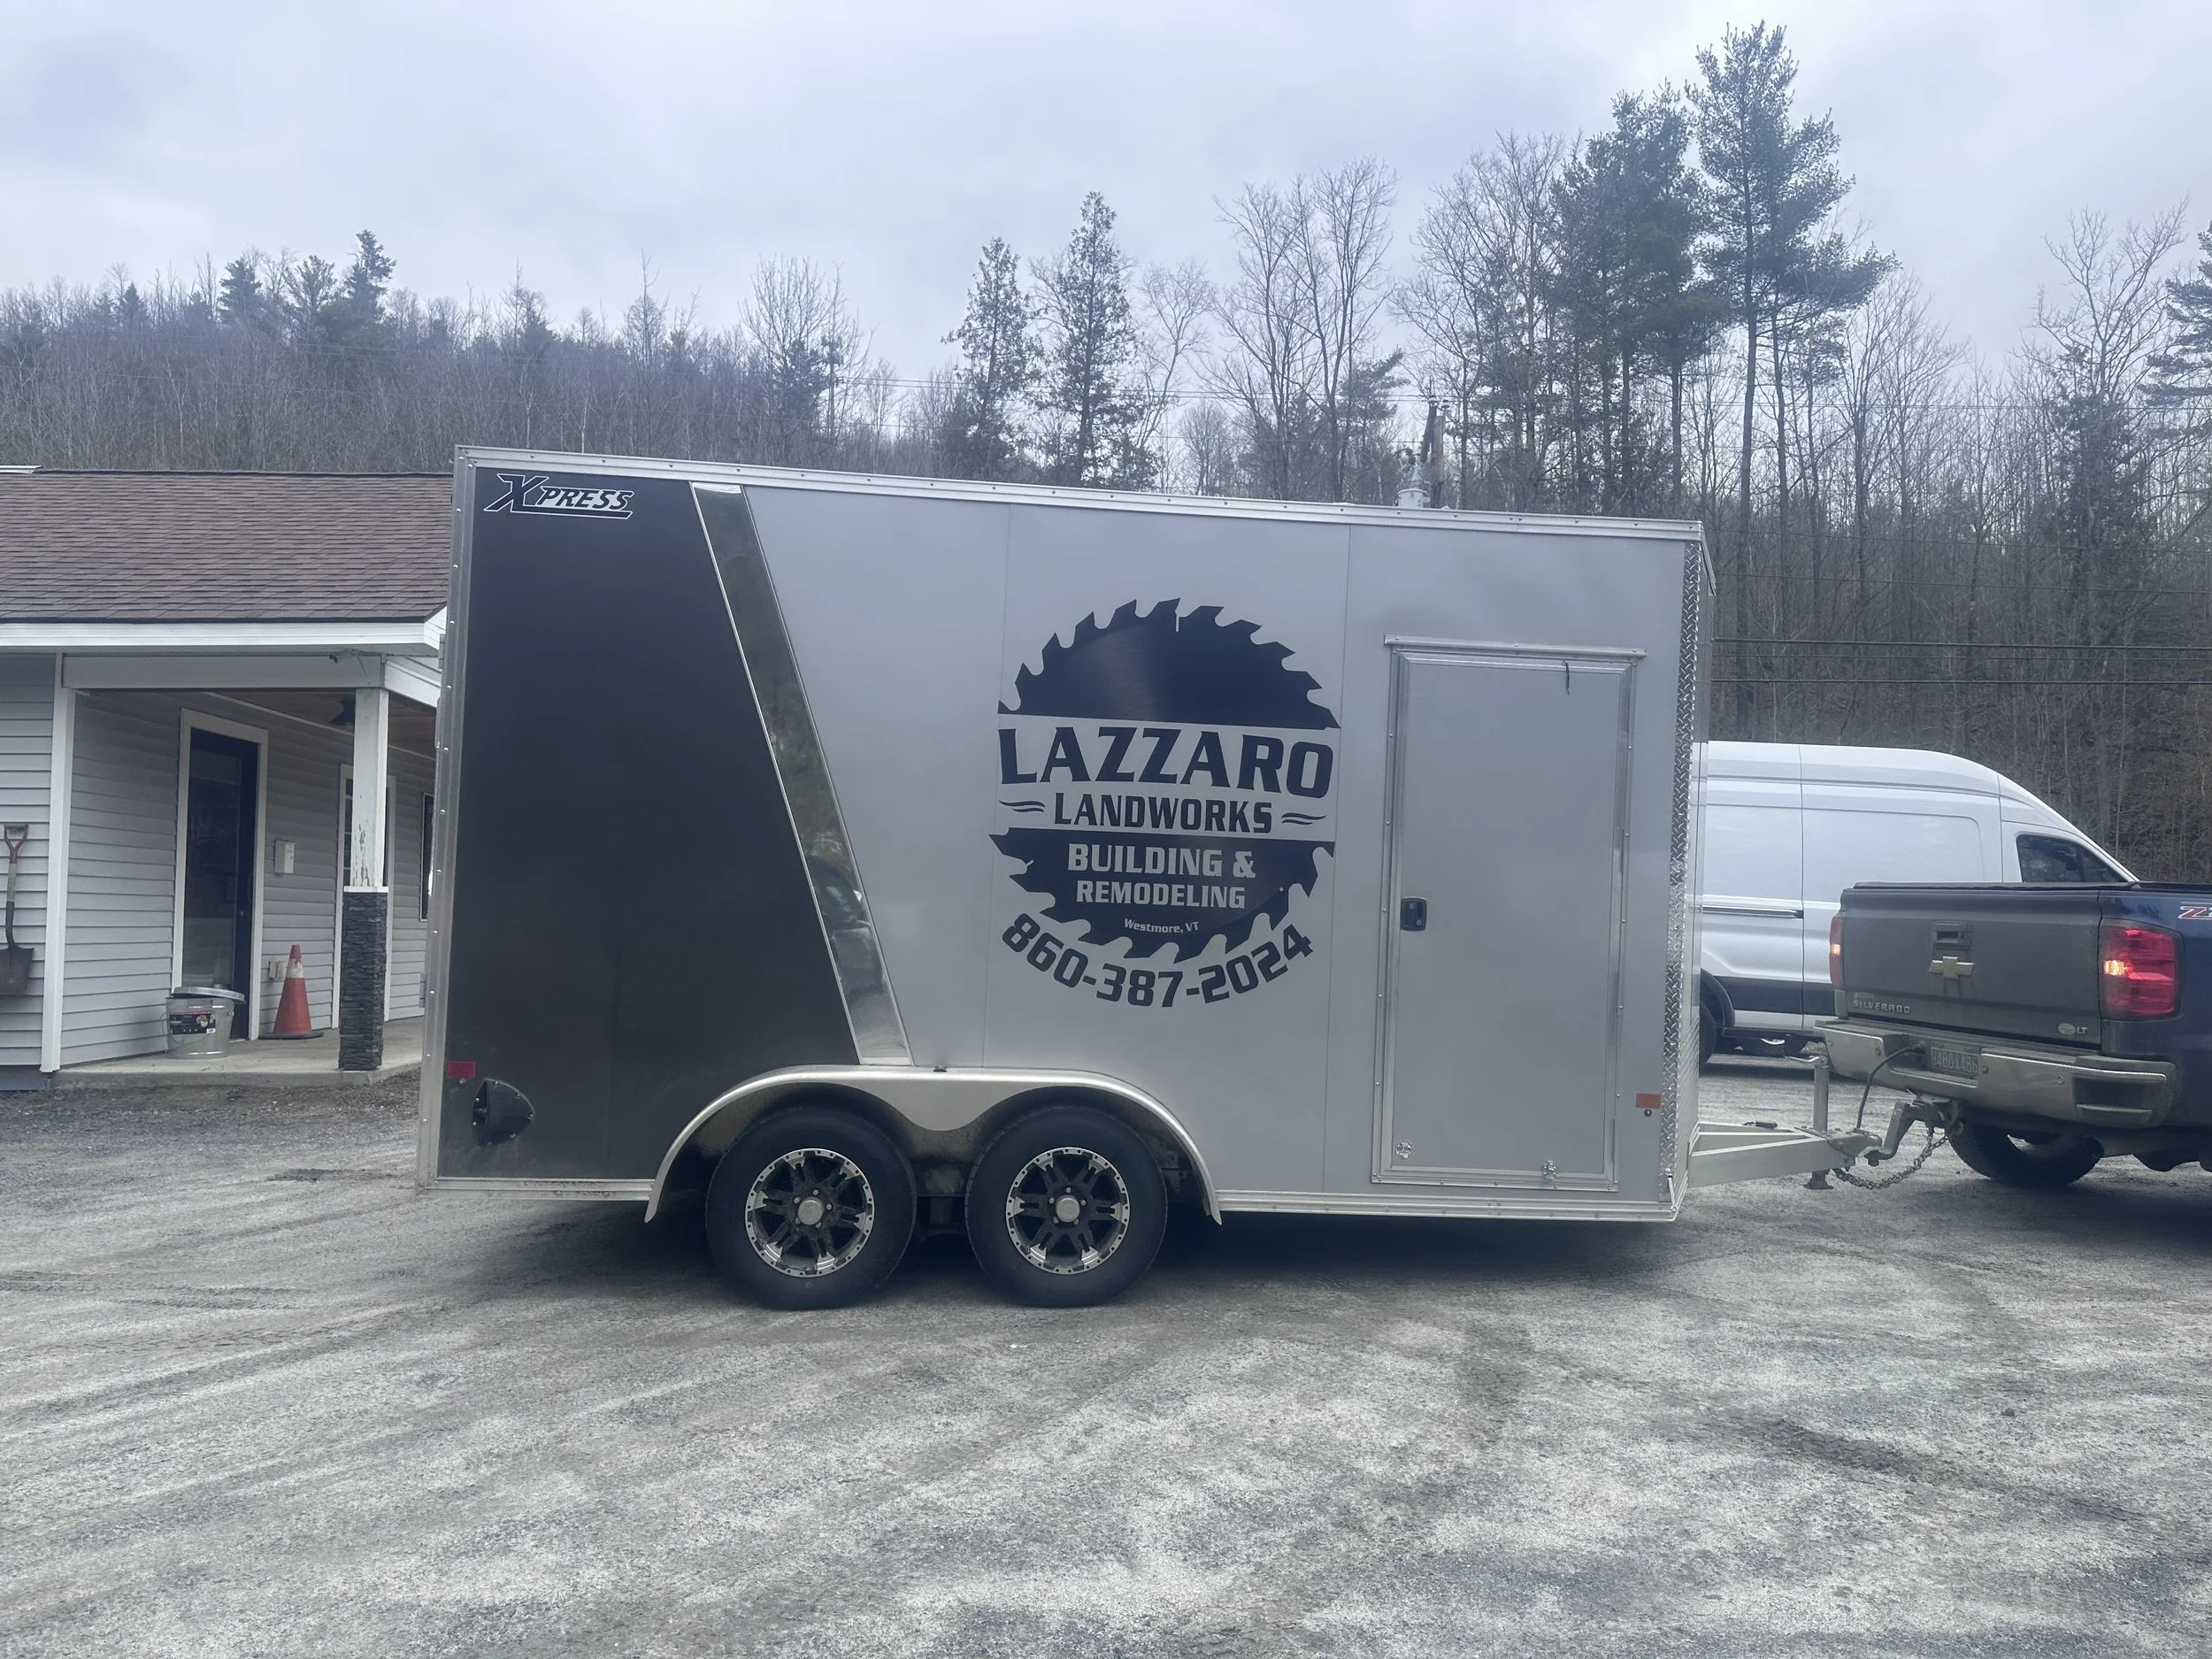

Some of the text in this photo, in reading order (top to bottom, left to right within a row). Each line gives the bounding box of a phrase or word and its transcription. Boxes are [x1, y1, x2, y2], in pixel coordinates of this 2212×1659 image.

[484, 473, 634, 518] XPRESS
[998, 726, 1334, 799] LAZZARO
[1055, 792, 1273, 833] LANDWORKS
[1067, 843, 1256, 879] BUILDING &
[1076, 879, 1246, 910] REMODELING
[1124, 918, 1200, 934] Westmore, VT
[1002, 913, 1314, 1008] 860-387-2024
[1853, 1000, 1911, 1014] SILVERADO
